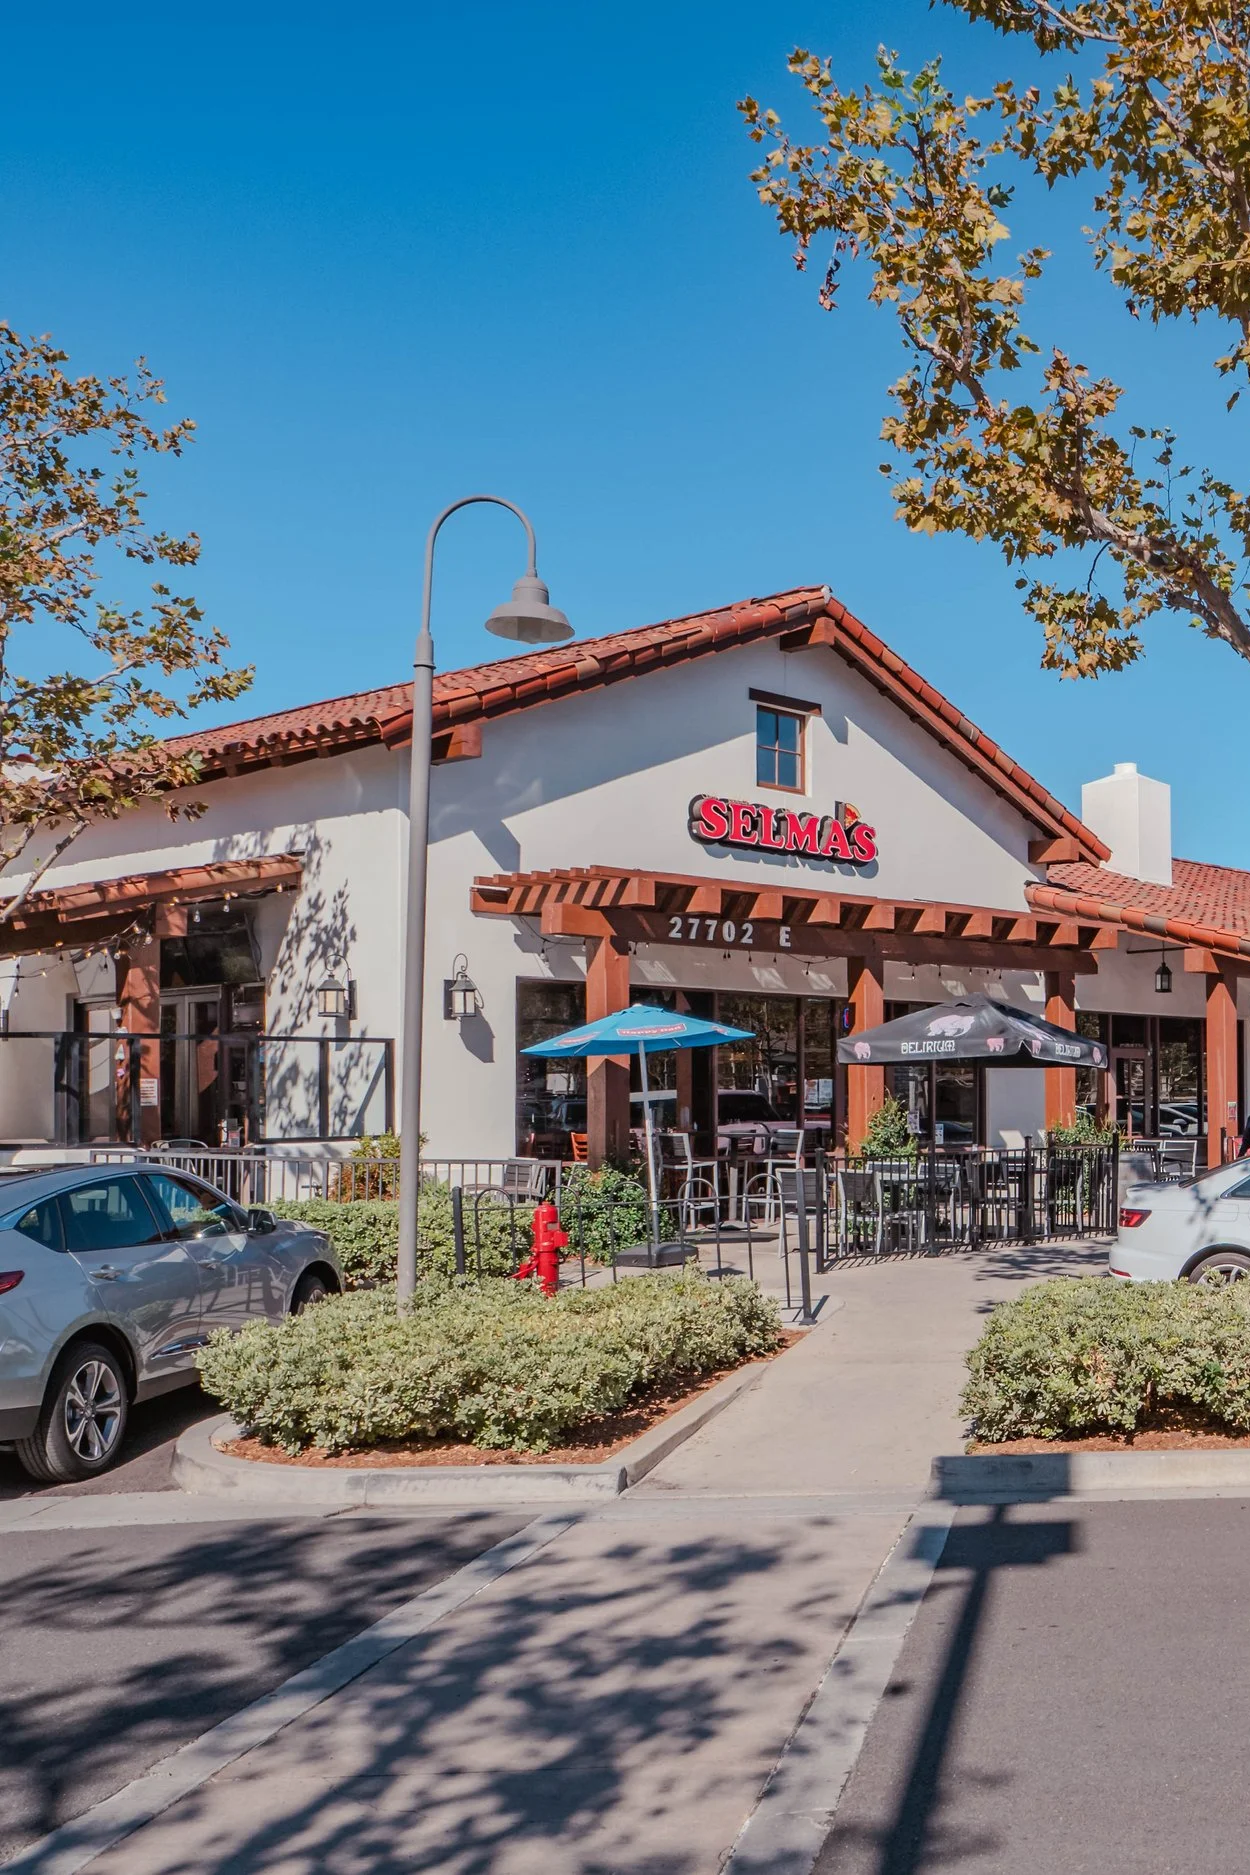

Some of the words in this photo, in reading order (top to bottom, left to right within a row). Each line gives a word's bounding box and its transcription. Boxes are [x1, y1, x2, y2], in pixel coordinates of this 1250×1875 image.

[668, 916, 754, 944] 27702
[779, 926, 792, 948] E
[901, 1040, 956, 1054] DELIRIUM
